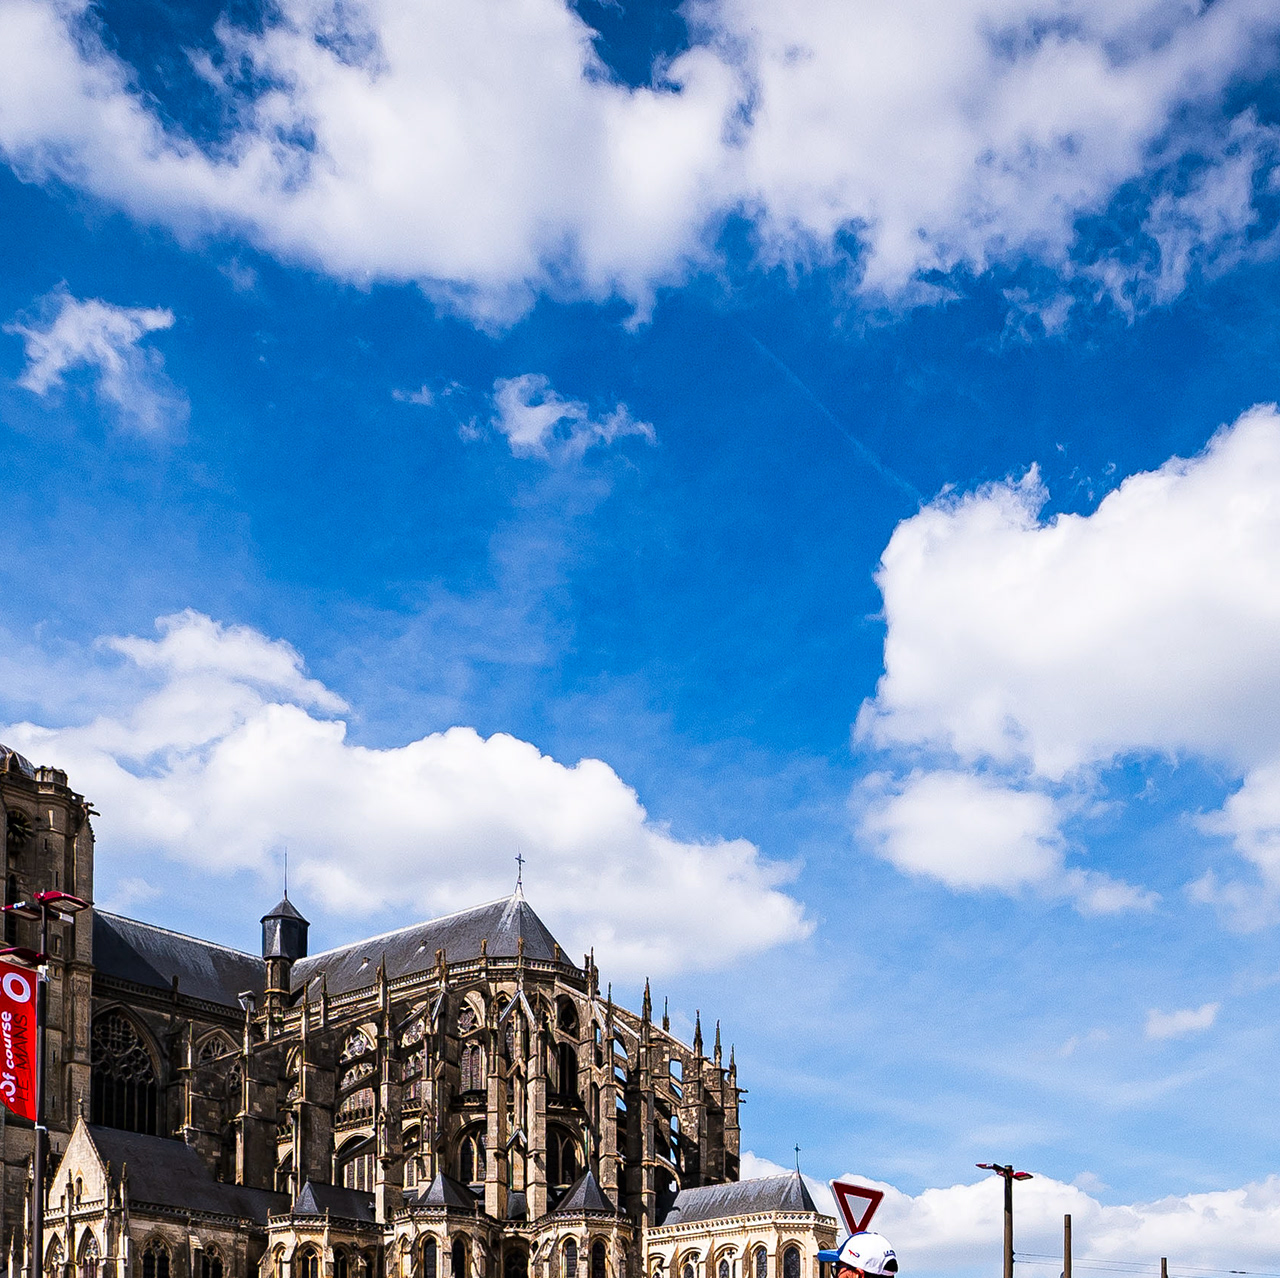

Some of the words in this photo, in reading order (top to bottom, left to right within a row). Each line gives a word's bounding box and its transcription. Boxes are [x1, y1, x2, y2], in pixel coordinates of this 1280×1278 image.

[0, 1010, 16, 1070] course
[13, 1013, 29, 1071] MANS
[15, 1076, 29, 1102] LE
